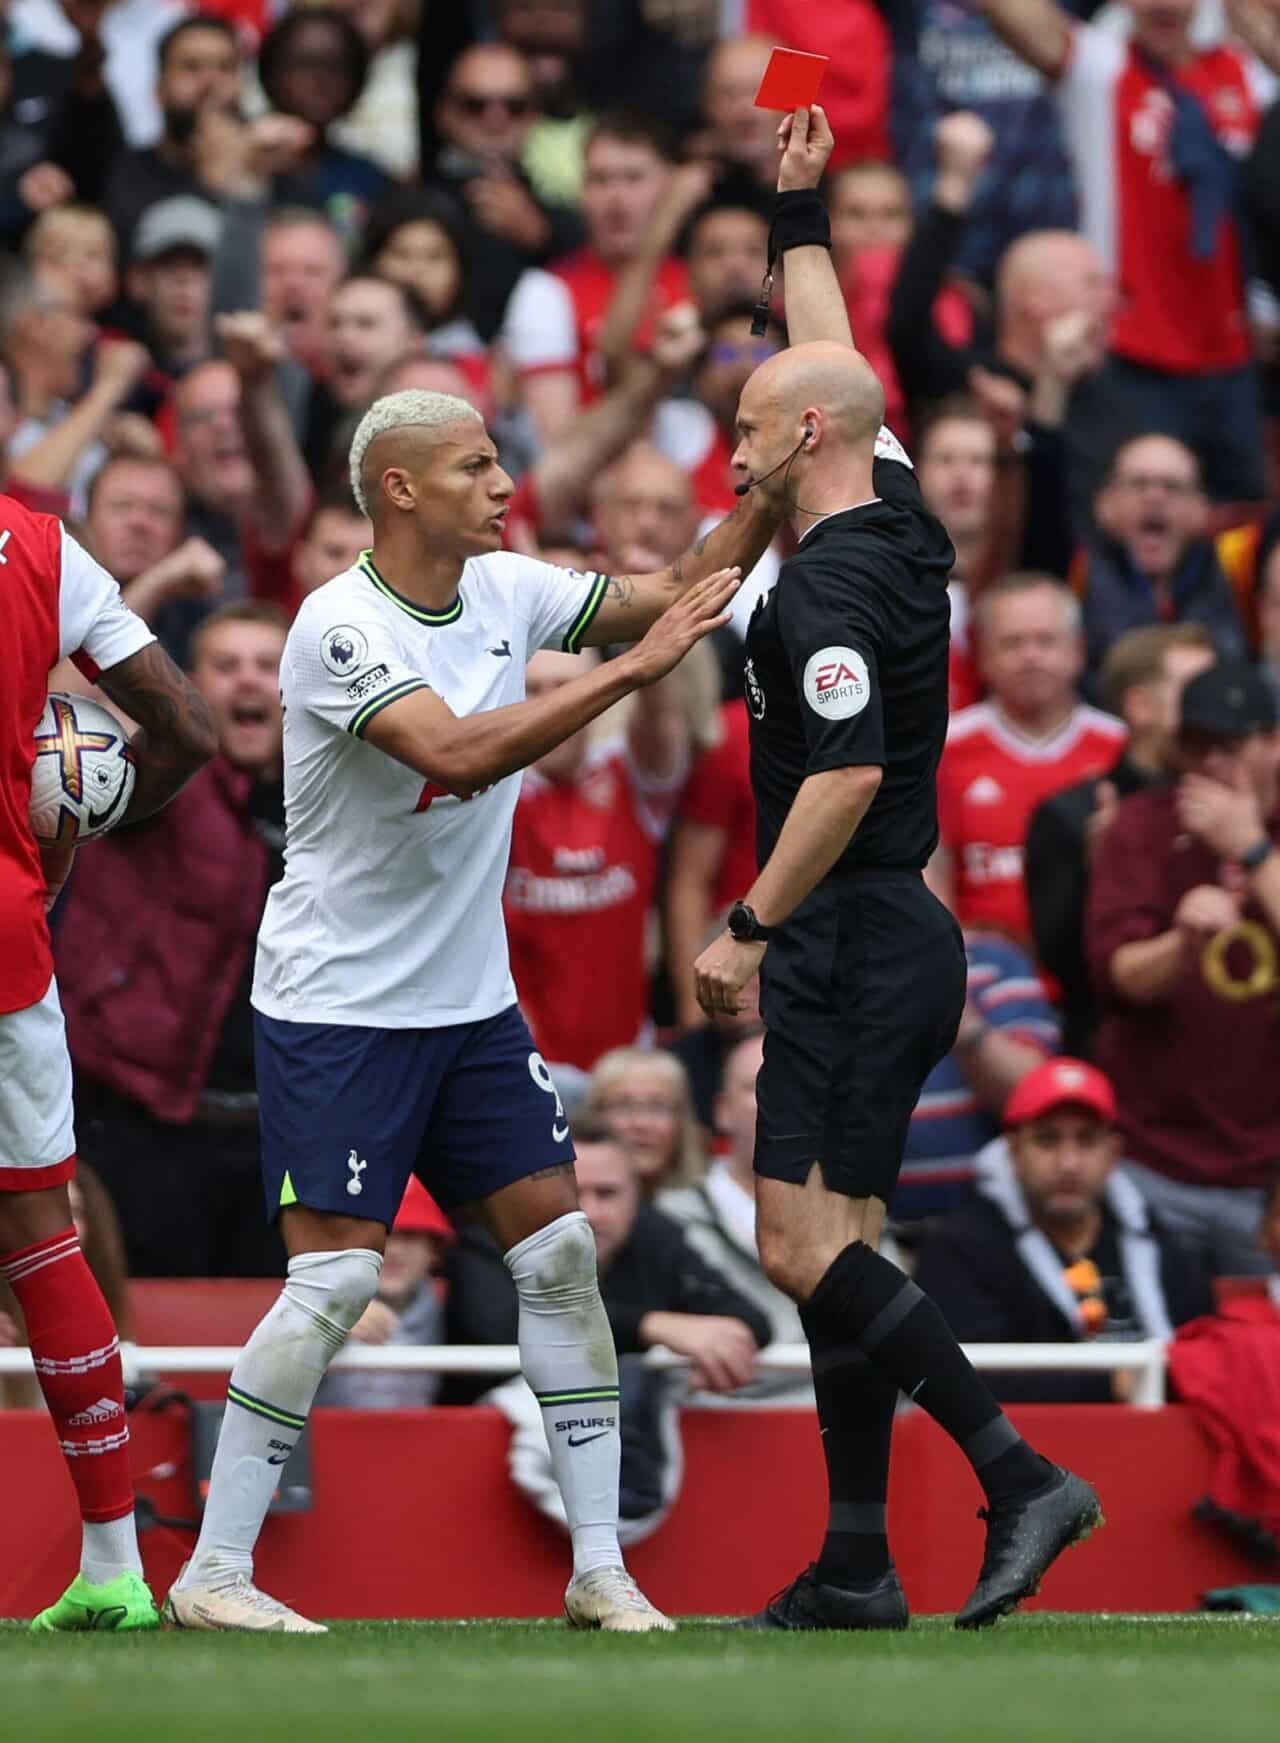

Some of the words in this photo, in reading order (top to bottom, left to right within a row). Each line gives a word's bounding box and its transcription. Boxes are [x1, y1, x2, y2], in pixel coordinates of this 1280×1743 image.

[815, 663, 860, 692] EA
[816, 683, 864, 705] SPORTS
[528, 1052, 564, 1118] 9
[554, 1416, 617, 1432] SPURS
